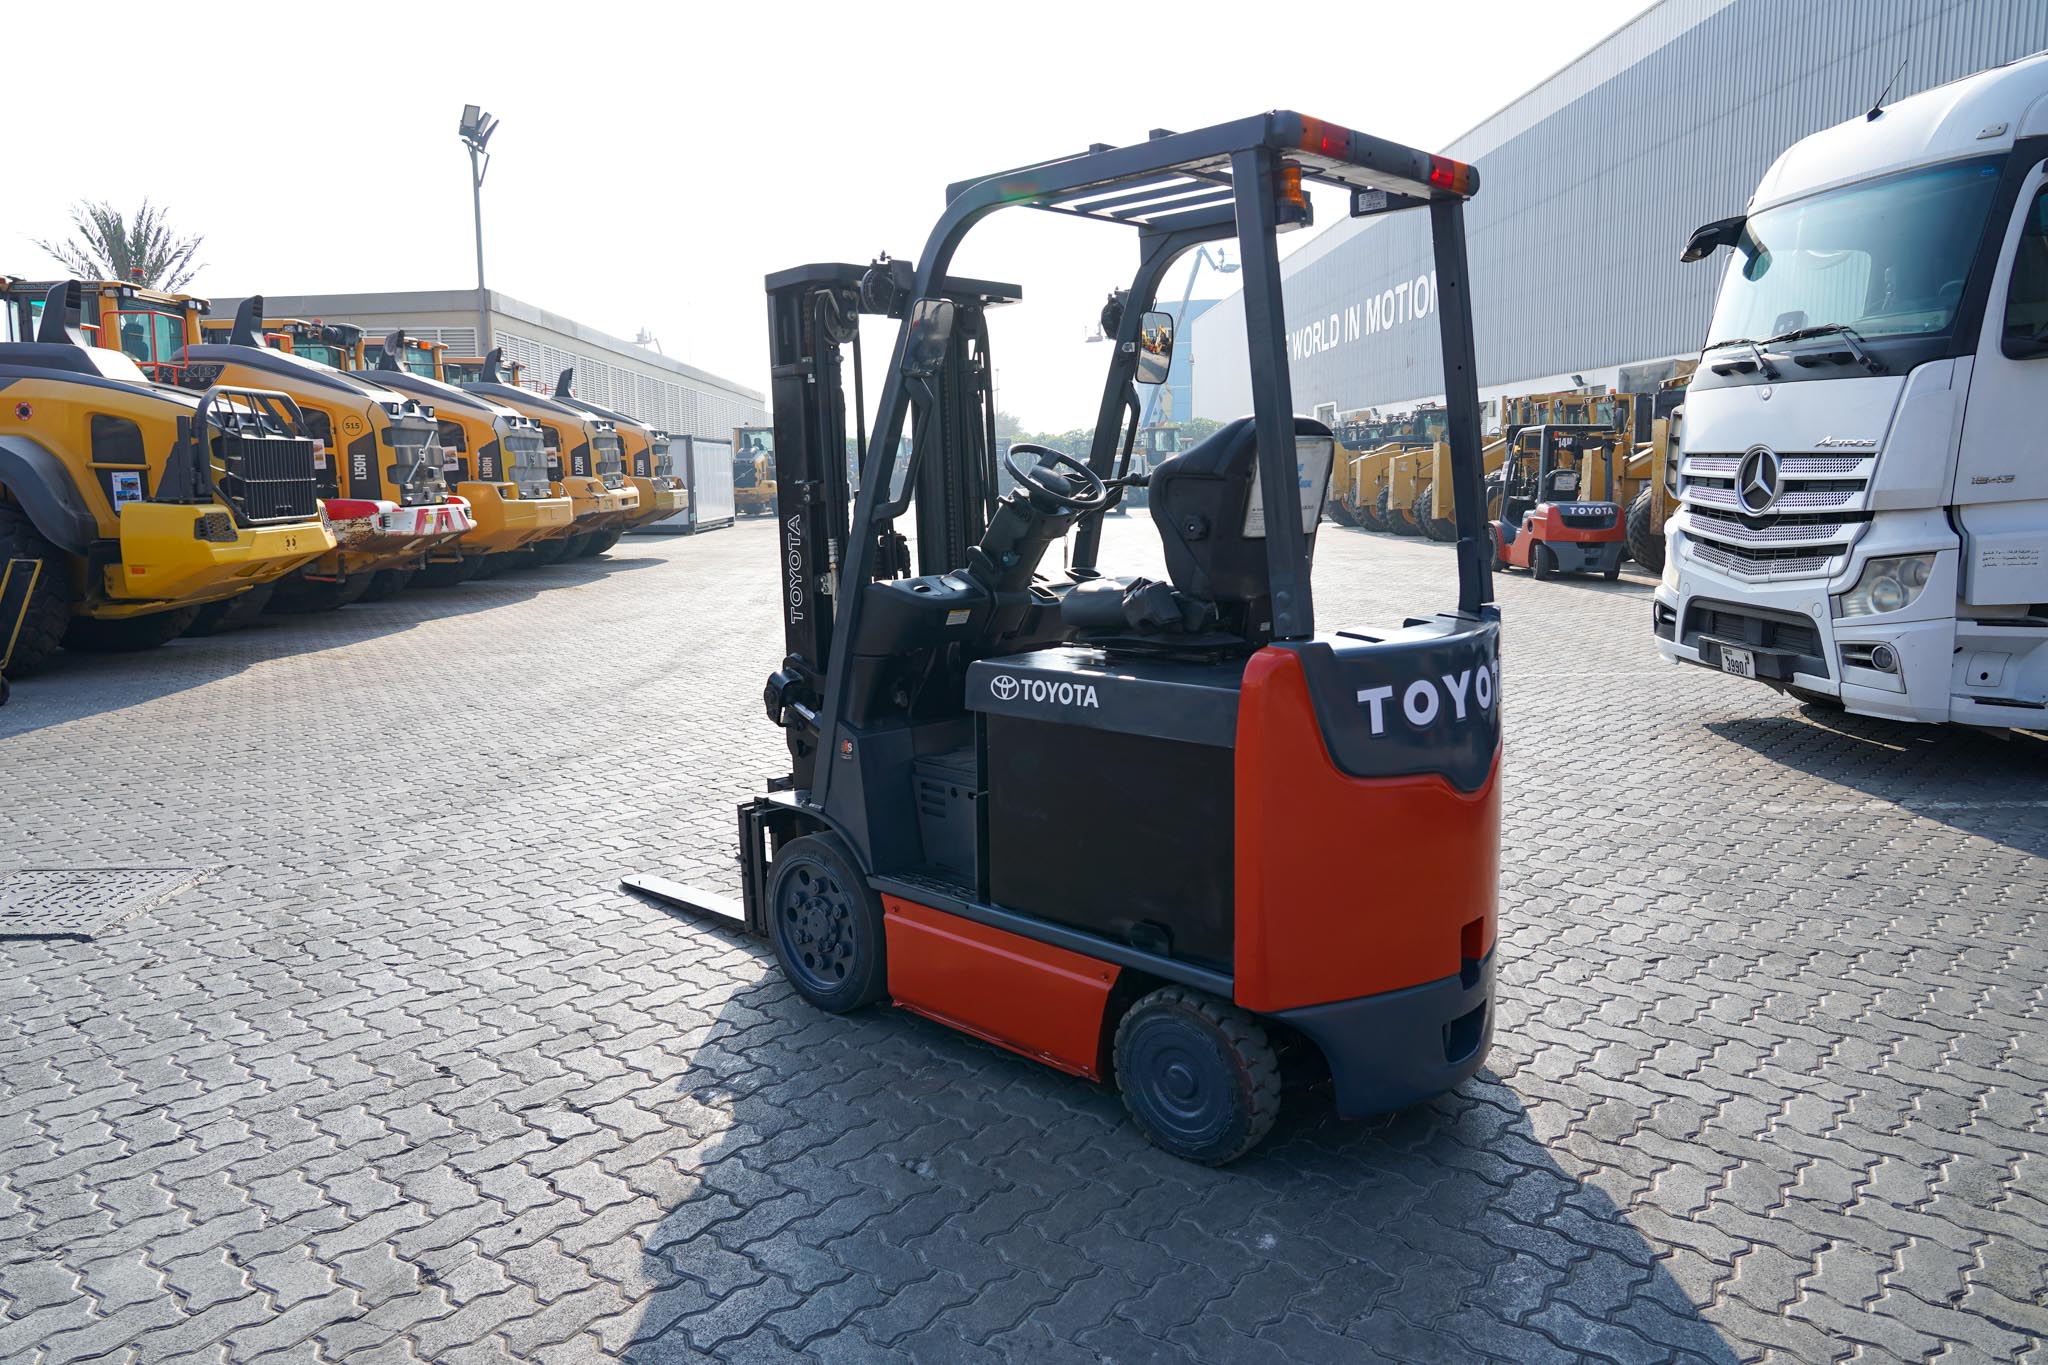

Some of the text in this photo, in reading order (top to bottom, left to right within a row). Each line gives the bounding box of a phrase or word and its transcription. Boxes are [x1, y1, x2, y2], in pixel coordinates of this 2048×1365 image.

[1292, 313, 1340, 361] WORLD
[1344, 303, 1361, 343] IN
[345, 422, 360, 430] 515
[353, 454, 367, 480] L150H
[482, 456, 493, 478] L180H
[574, 456, 584, 475] L220H
[1569, 507, 1614, 515] TOYOTA
[787, 514, 804, 625] TOYOTA
[1020, 679, 1099, 708] TOYOTA
